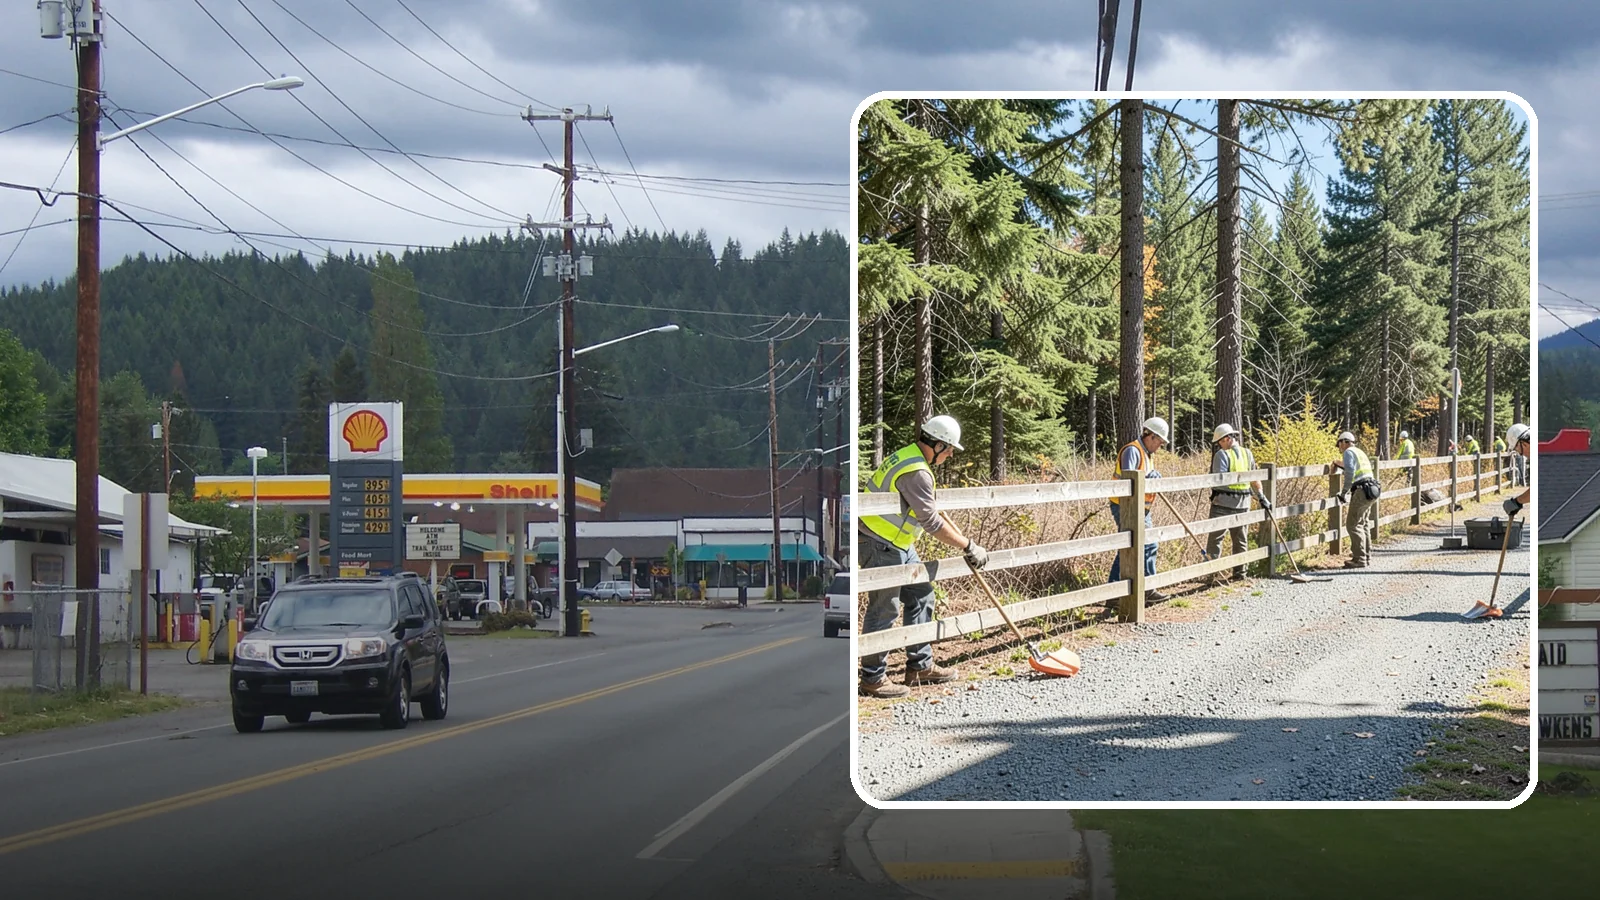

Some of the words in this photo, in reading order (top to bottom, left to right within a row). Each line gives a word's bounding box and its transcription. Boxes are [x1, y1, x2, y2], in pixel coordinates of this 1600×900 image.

[365, 480, 383, 490] 395
[490, 484, 547, 499] Shell
[366, 494, 383, 504] 405
[366, 508, 383, 518] 415
[366, 522, 383, 532] 429
[1538, 642, 1566, 666] AID
